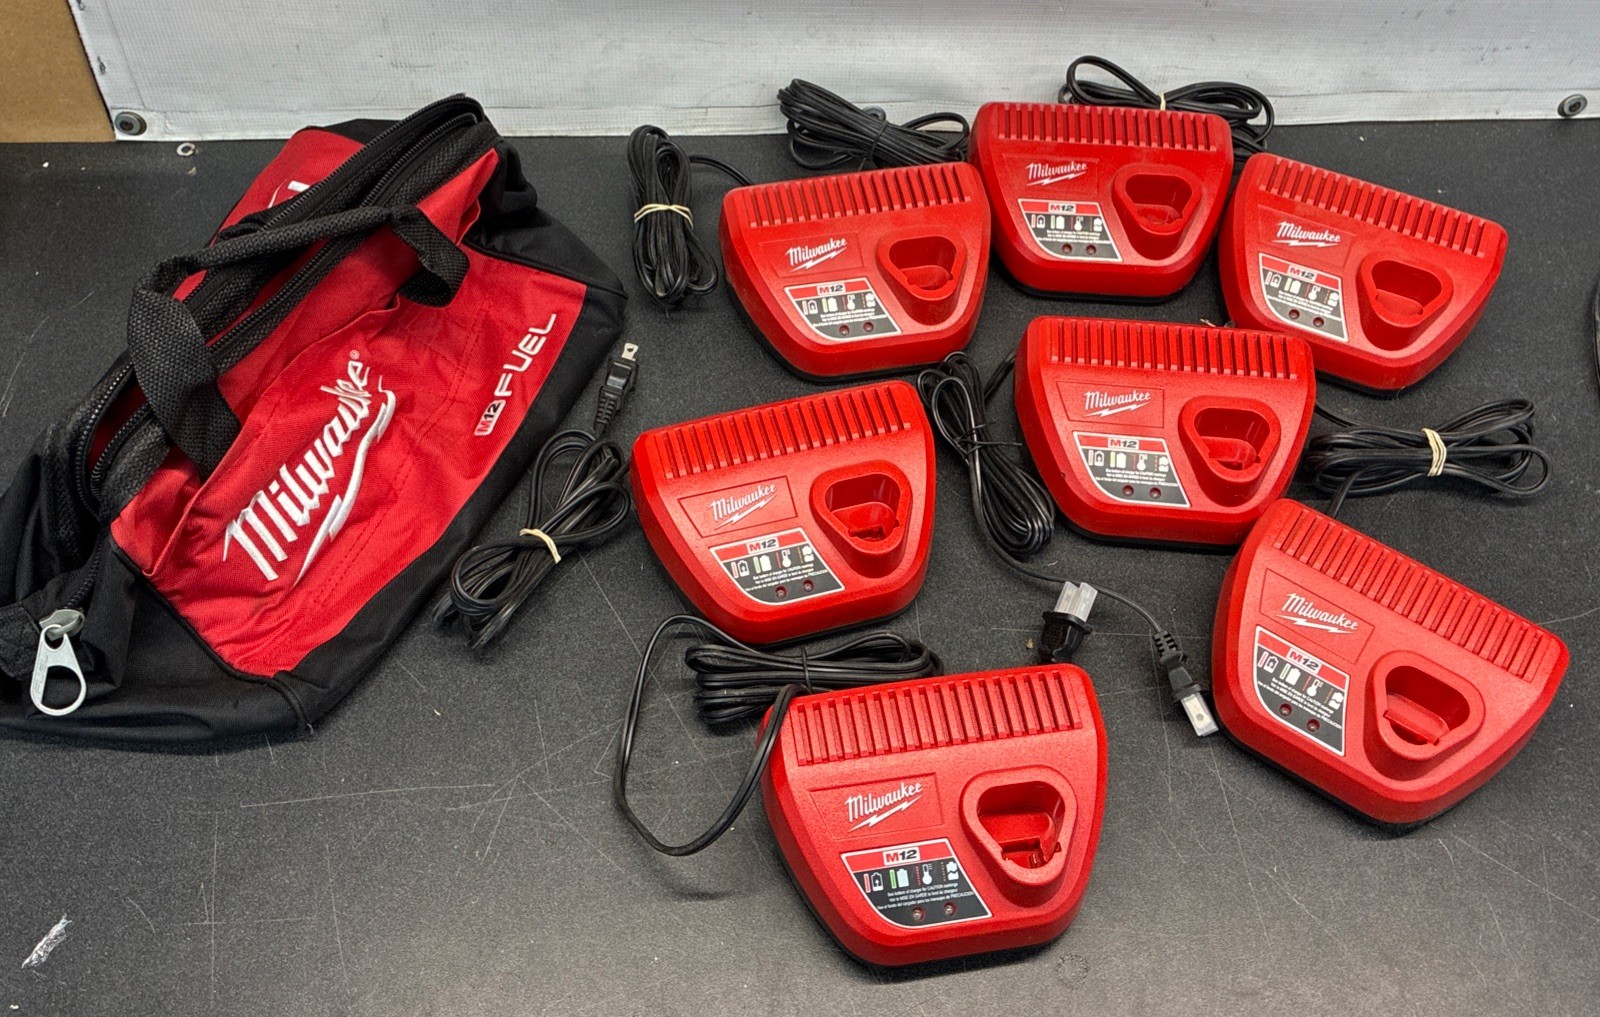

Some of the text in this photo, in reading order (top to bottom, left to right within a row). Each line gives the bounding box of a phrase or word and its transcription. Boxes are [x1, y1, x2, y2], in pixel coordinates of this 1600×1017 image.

[1025, 161, 1087, 180] Milwaukee
[1050, 204, 1075, 212] M12
[1276, 220, 1341, 243] Milwaukee
[785, 238, 847, 266] Milwaukee
[1289, 267, 1315, 279] M12
[819, 284, 844, 294] M12
[476, 313, 557, 433] M12 FUEL
[1083, 389, 1151, 410] Milwaukee
[1110, 439, 1138, 448] M12
[708, 483, 777, 522] Milwaukee
[749, 538, 777, 552] M12
[1281, 592, 1359, 630] Milwaukee
[1289, 649, 1320, 671] M12
[843, 781, 923, 823] Milwaukee
[885, 849, 918, 864] M12
